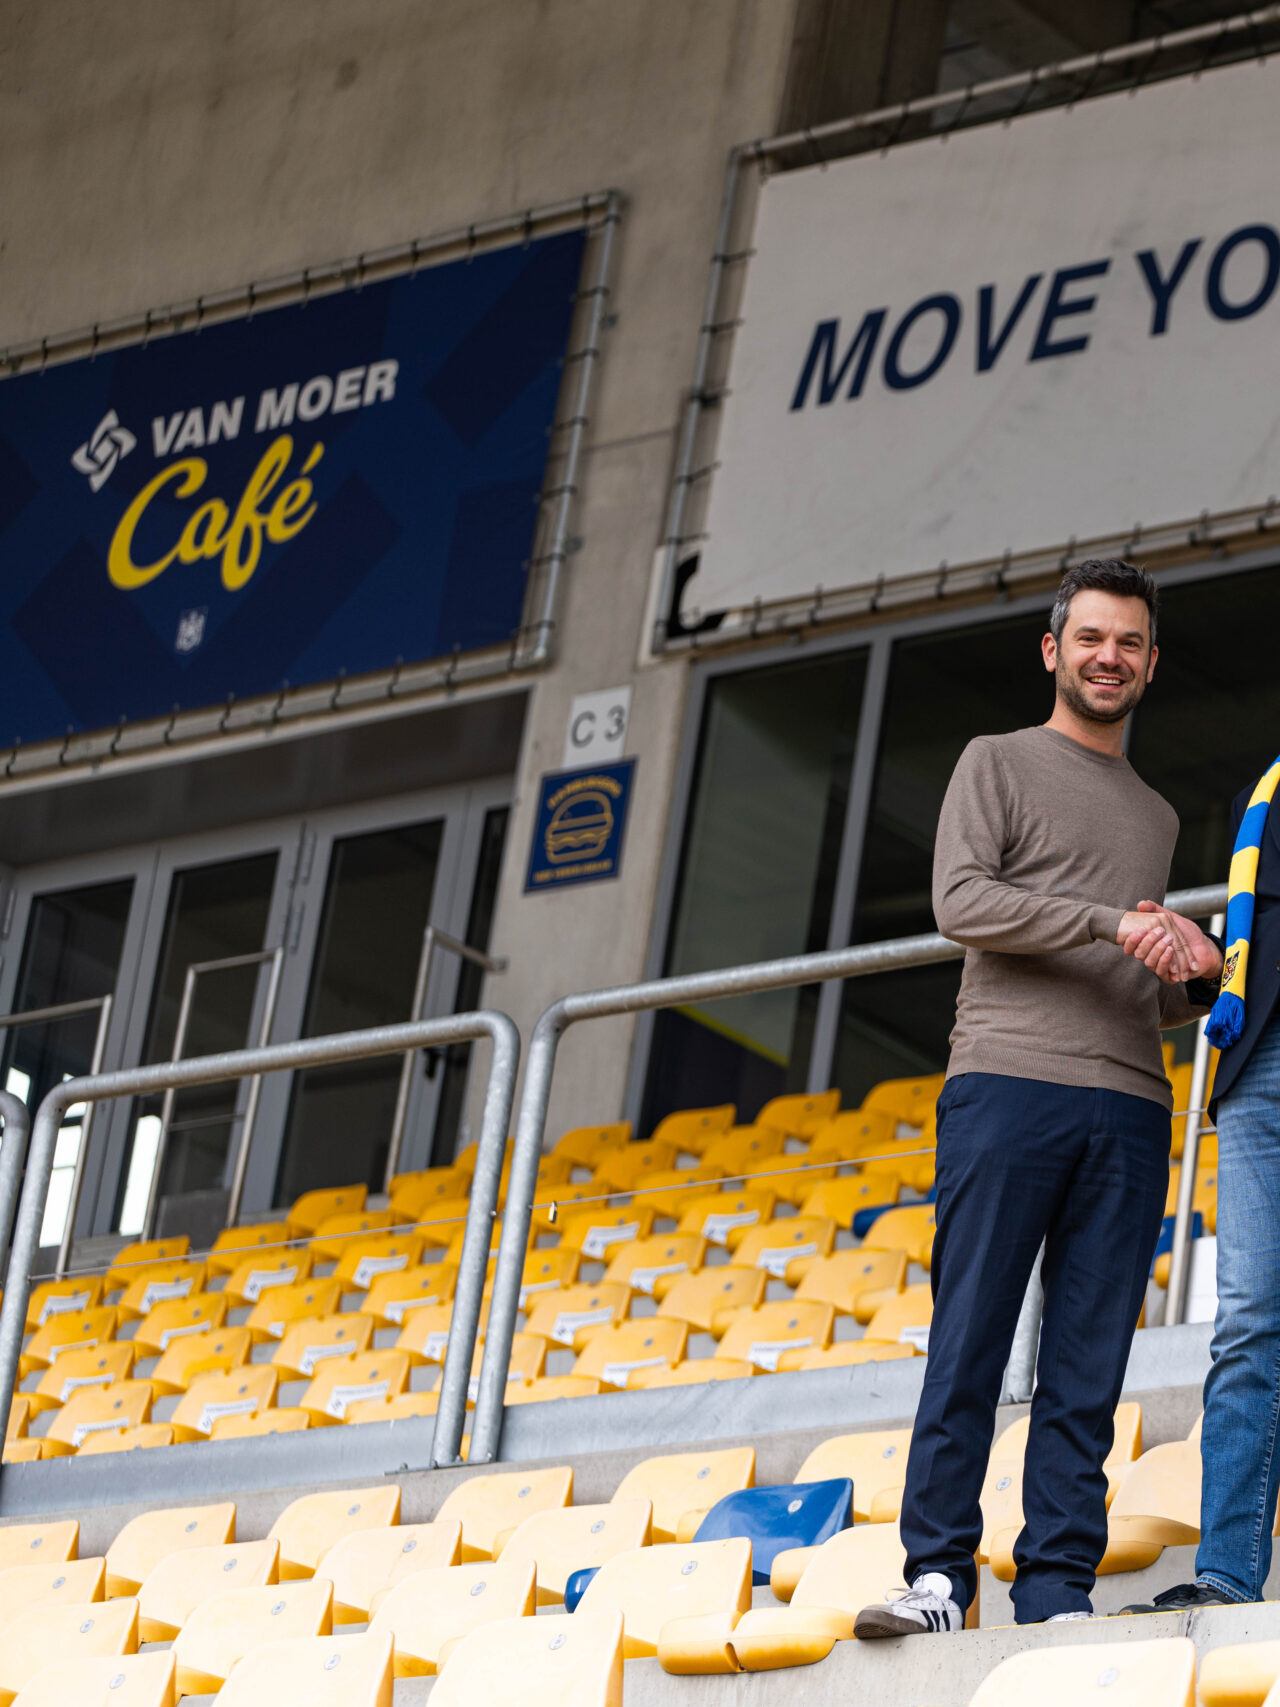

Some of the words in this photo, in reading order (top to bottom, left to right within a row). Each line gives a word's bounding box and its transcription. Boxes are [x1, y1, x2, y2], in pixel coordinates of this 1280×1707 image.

[790, 258, 1112, 412] MOVE
[152, 397, 245, 457] VAN
[256, 360, 398, 432] MOER
[107, 435, 325, 591] Café
[571, 710, 596, 749] C
[604, 704, 626, 742] 3
